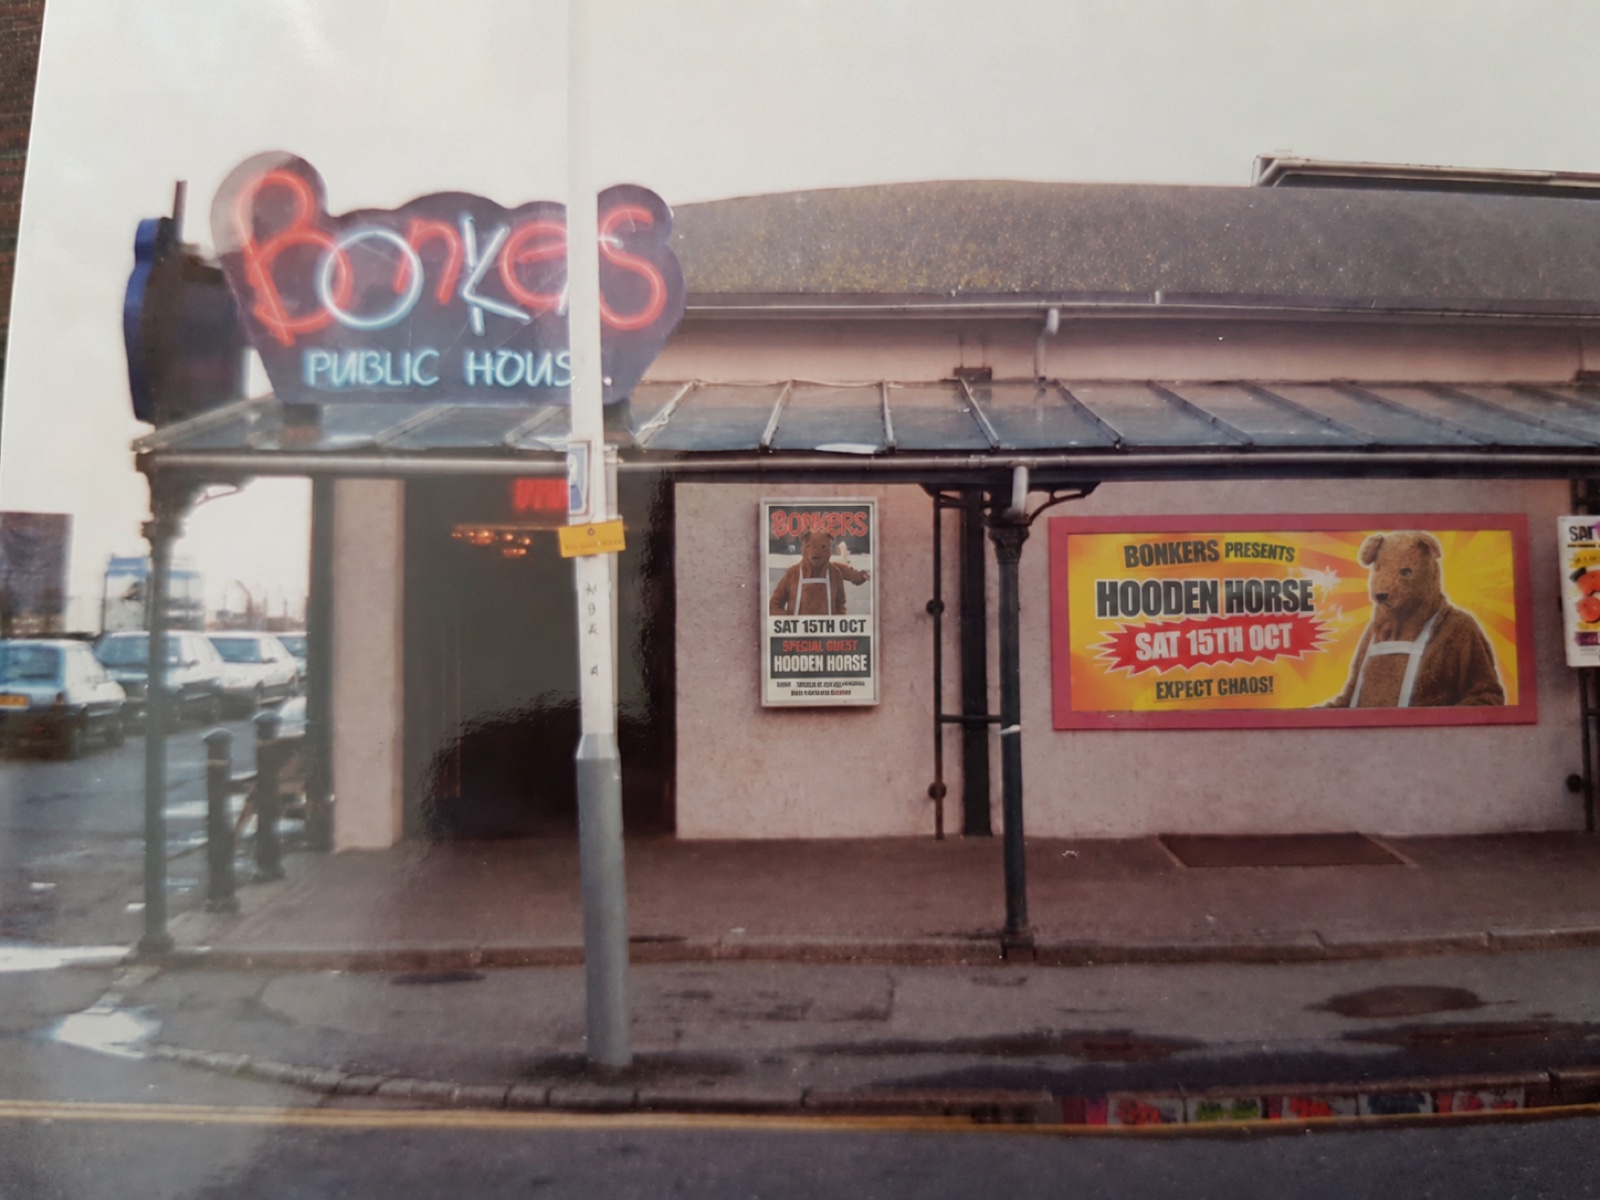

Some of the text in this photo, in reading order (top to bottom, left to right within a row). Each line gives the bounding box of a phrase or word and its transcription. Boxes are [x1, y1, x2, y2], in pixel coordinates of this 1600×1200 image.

[307, 350, 573, 386] PUBLIC HOUS
[771, 509, 868, 539] BONKERS
[1123, 539, 1296, 568] BONKERS PRESENTS
[1096, 578, 1315, 618] HOODEN HORSE
[773, 618, 867, 634] SAT 15TH OCT
[782, 640, 823, 652] SPECIAL
[1135, 623, 1293, 661] SAT 15TH OCT
[774, 654, 868, 672] HOODEN HORSE
[1155, 676, 1274, 700] EXPECT CHAOS!
